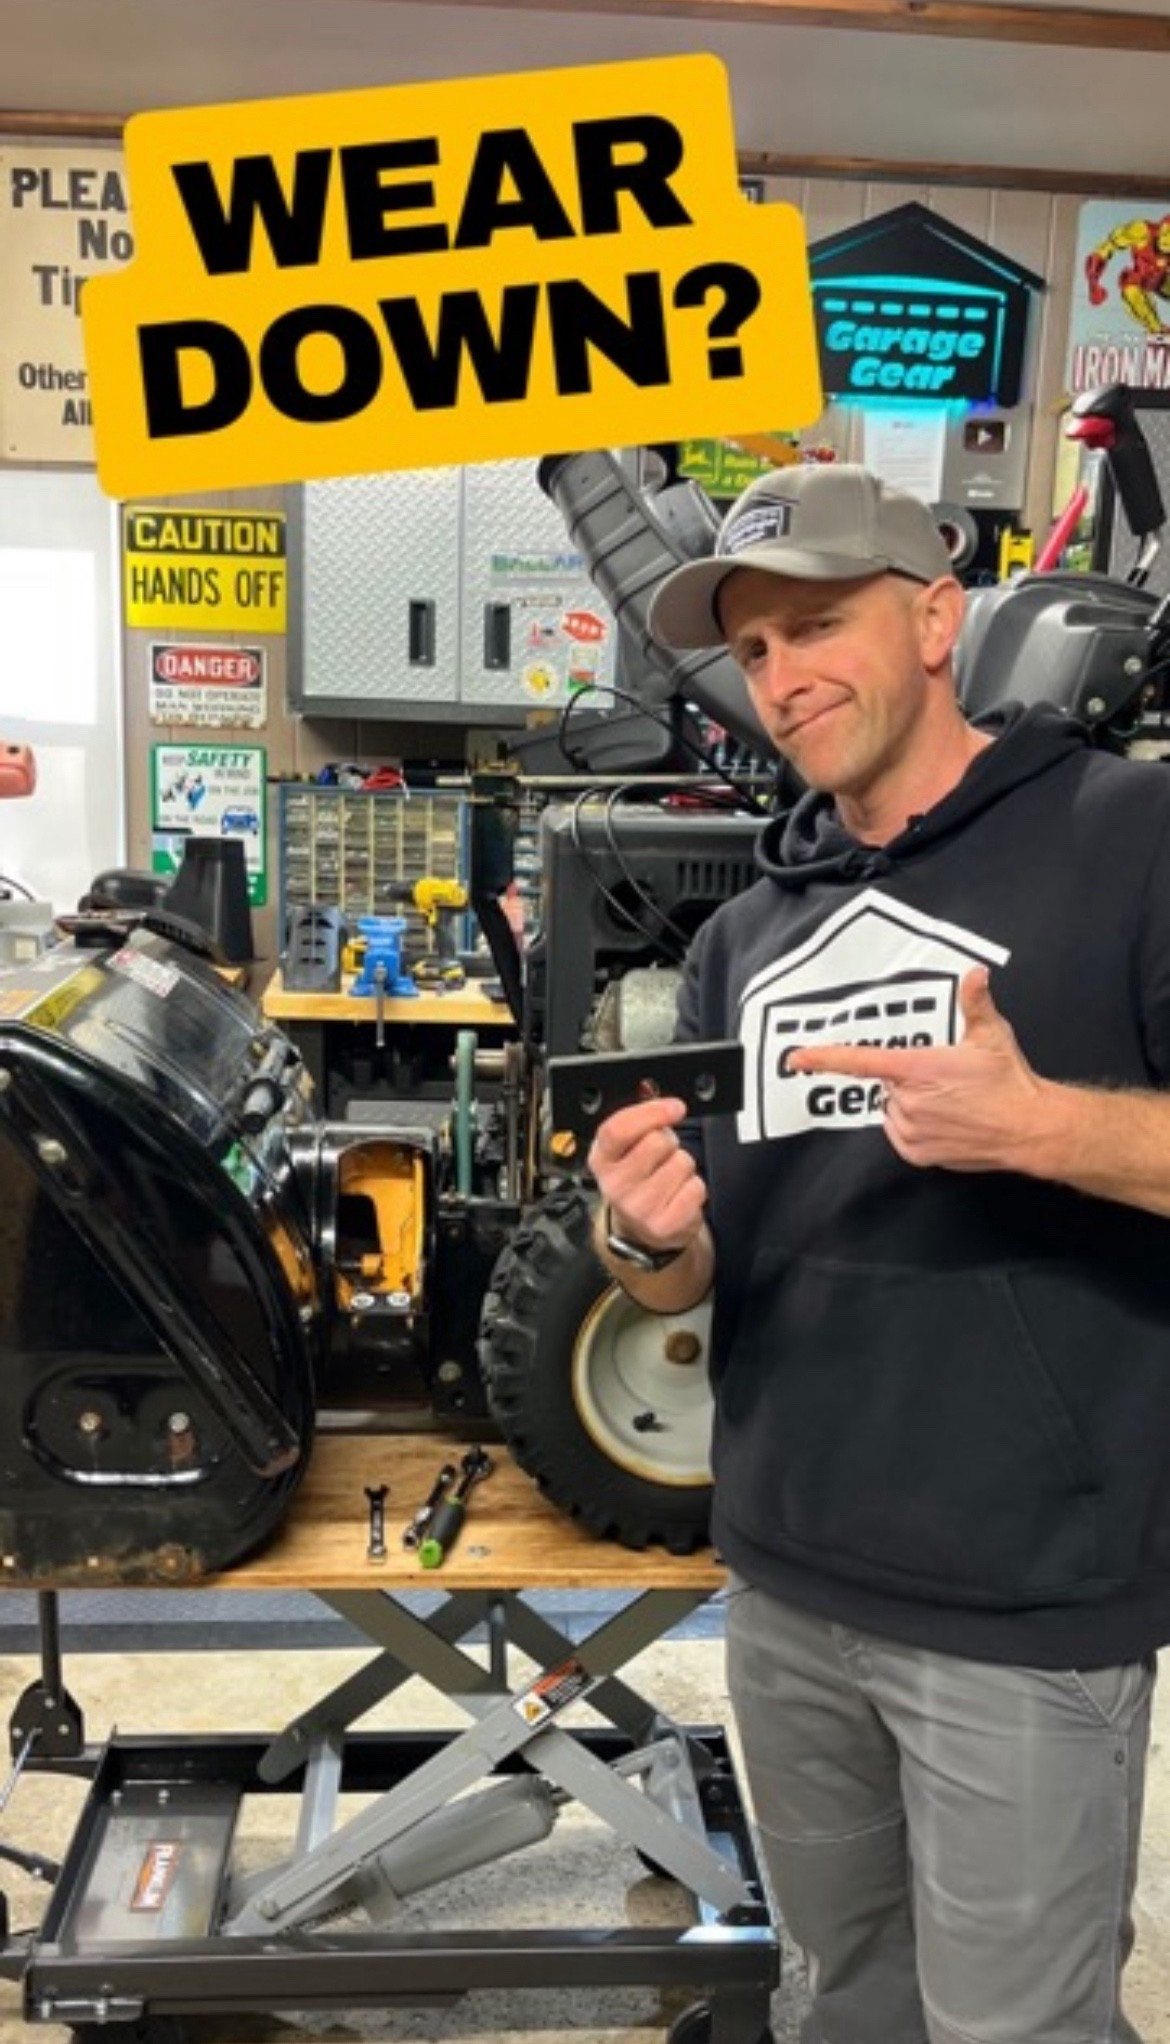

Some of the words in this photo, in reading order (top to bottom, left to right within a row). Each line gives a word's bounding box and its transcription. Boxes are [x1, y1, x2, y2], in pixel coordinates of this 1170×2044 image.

[79, 219, 134, 260] No
[826, 321, 985, 361] Garage
[851, 356, 956, 390] Gear
[134, 516, 278, 553] CAUTION
[131, 565, 221, 606] HANDS
[235, 569, 284, 608] OFF
[164, 654, 253, 680] DANGER
[186, 750, 255, 767] SAFETY
